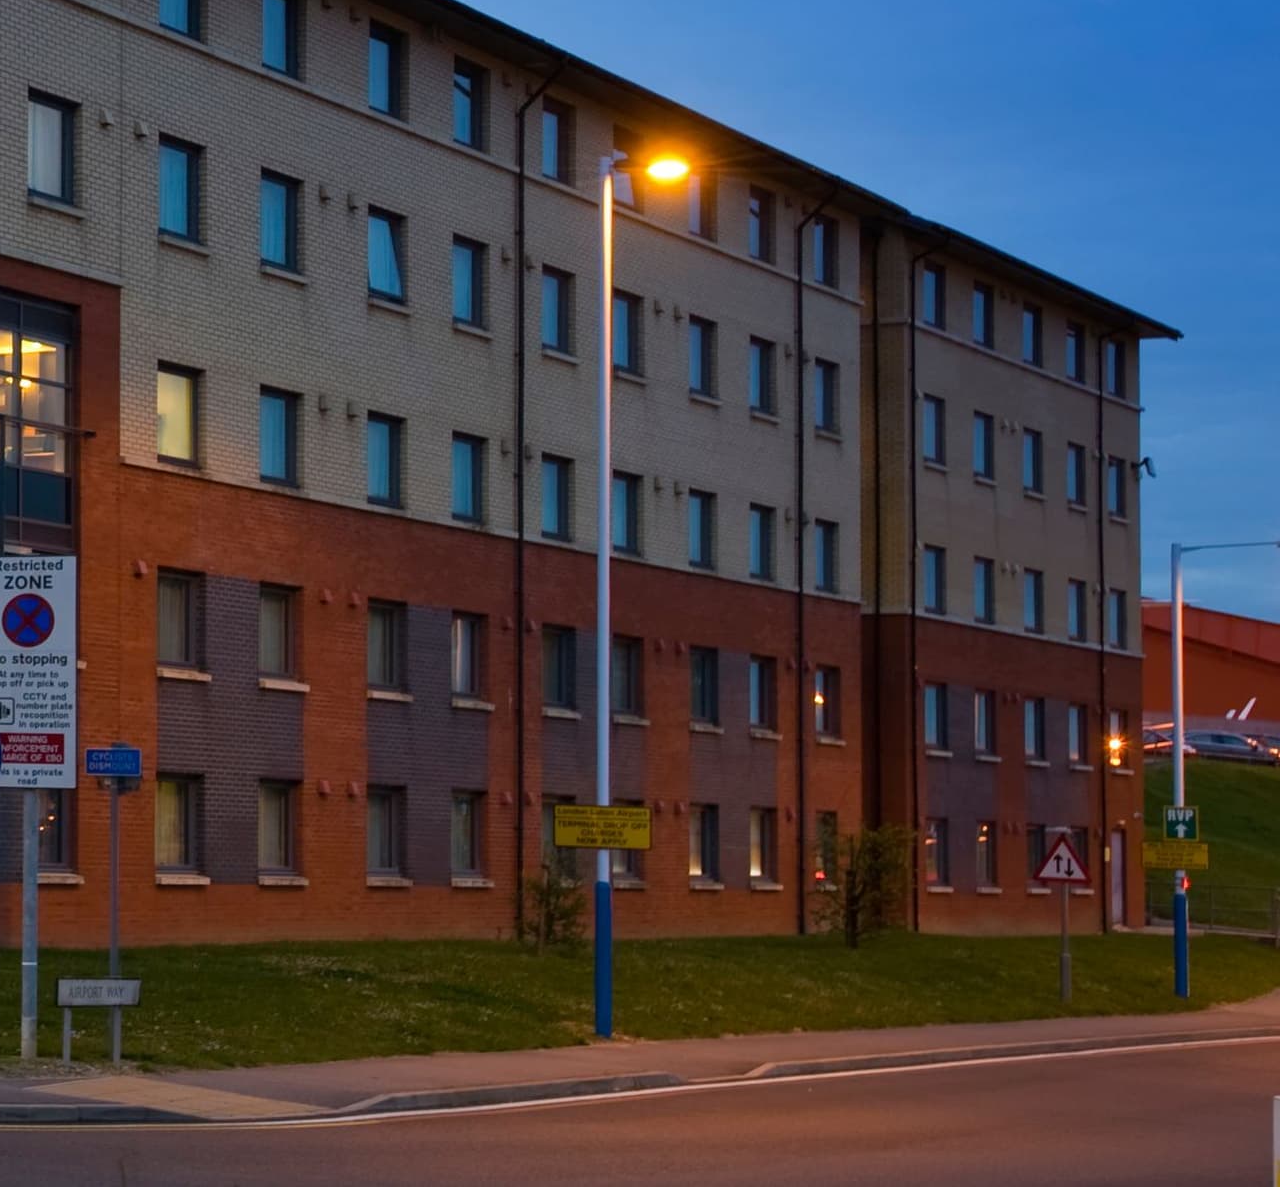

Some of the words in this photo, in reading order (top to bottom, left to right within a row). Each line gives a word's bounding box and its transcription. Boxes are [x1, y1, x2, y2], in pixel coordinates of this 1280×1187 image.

[4, 575, 53, 589] ZONE
[11, 653, 68, 666] stopping
[10, 671, 24, 679] any
[28, 670, 46, 678] time
[37, 680, 54, 688] pick
[7, 735, 48, 743] WARNING
[1, 744, 59, 752] NFORCEMENT
[89, 762, 135, 771] DISMOUNT
[32, 768, 63, 776] private
[1167, 809, 1194, 821] RVP
[558, 820, 601, 828] TERMINAL
[68, 986, 104, 998] AIRPORT
[107, 986, 125, 998] WAY
